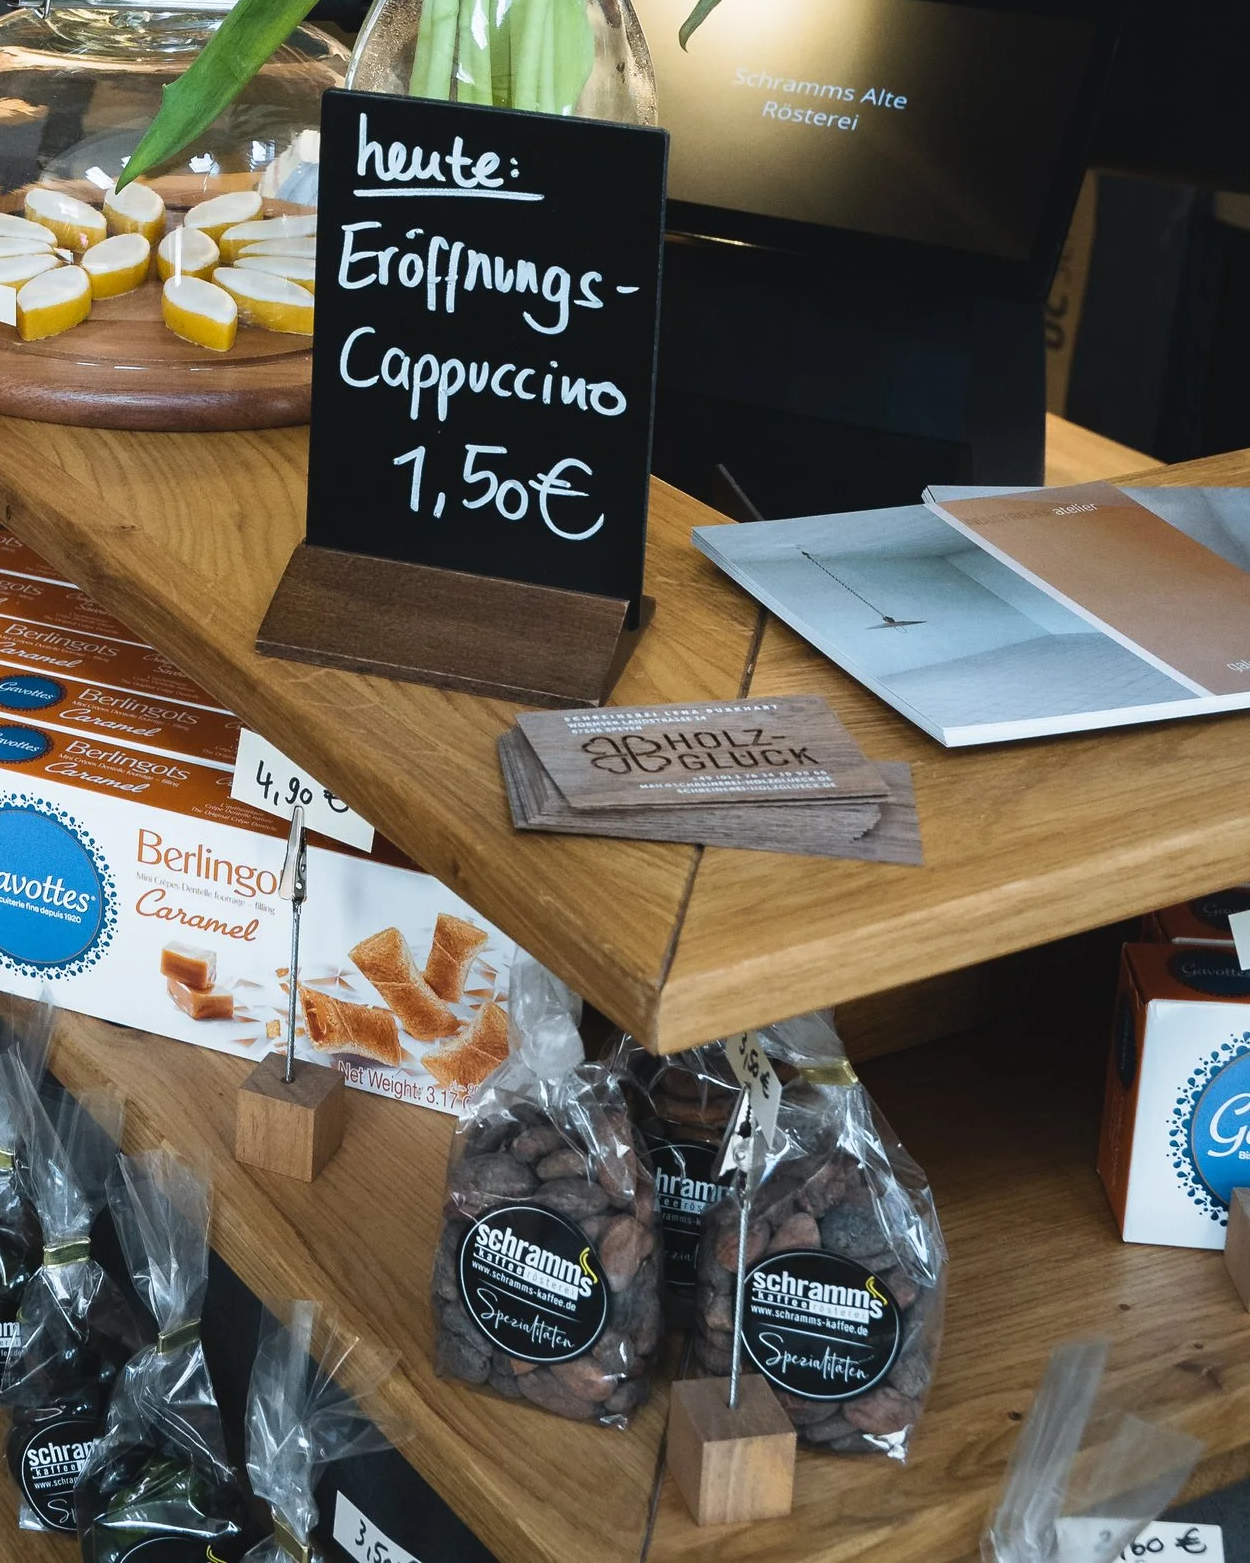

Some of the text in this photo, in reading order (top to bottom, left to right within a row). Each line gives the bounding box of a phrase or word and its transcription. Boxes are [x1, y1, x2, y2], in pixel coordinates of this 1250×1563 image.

[733, 66, 908, 110] Schramms Alte
[762, 100, 860, 132] Rösterei
[356, 112, 520, 188] heute:
[338, 221, 641, 334] Eröffnungs-
[338, 326, 628, 421] Cappuccino
[393, 444, 605, 540] 1,50€
[1052, 500, 1099, 517] atelier
[4, 623, 121, 657] Berlingots
[58, 708, 163, 737] Caramel
[77, 688, 201, 725] Berlingots
[65, 740, 191, 780] Berlingots
[662, 728, 787, 752] HOLZ-
[44, 761, 151, 793] Caramel
[256, 759, 313, 806] 4,90
[137, 828, 282, 898] Berlingo
[25, 902, 40, 913] fine
[39, 906, 65, 922] depuis
[64, 912, 82, 924] 1920
[135, 888, 260, 942] Caramel
[136, 871, 153, 883] Mini
[154, 876, 181, 890] Crêpes
[181, 882, 214, 898] Dentelle
[255, 901, 277, 916] filling
[338, 1059, 364, 1085] Net
[367, 1067, 422, 1101] Weight:
[426, 1085, 459, 1110] 3.17
[475, 1223, 593, 1298] schramms
[471, 1259, 577, 1312] www.schramms-kaffee.de
[752, 1270, 883, 1319] schramms
[477, 1287, 575, 1349] Spezialitäten
[750, 1304, 869, 1337] www.schramms-kaffee.de
[758, 1331, 870, 1383] Spezialitäten
[1174, 1527, 1207, 1554] €
